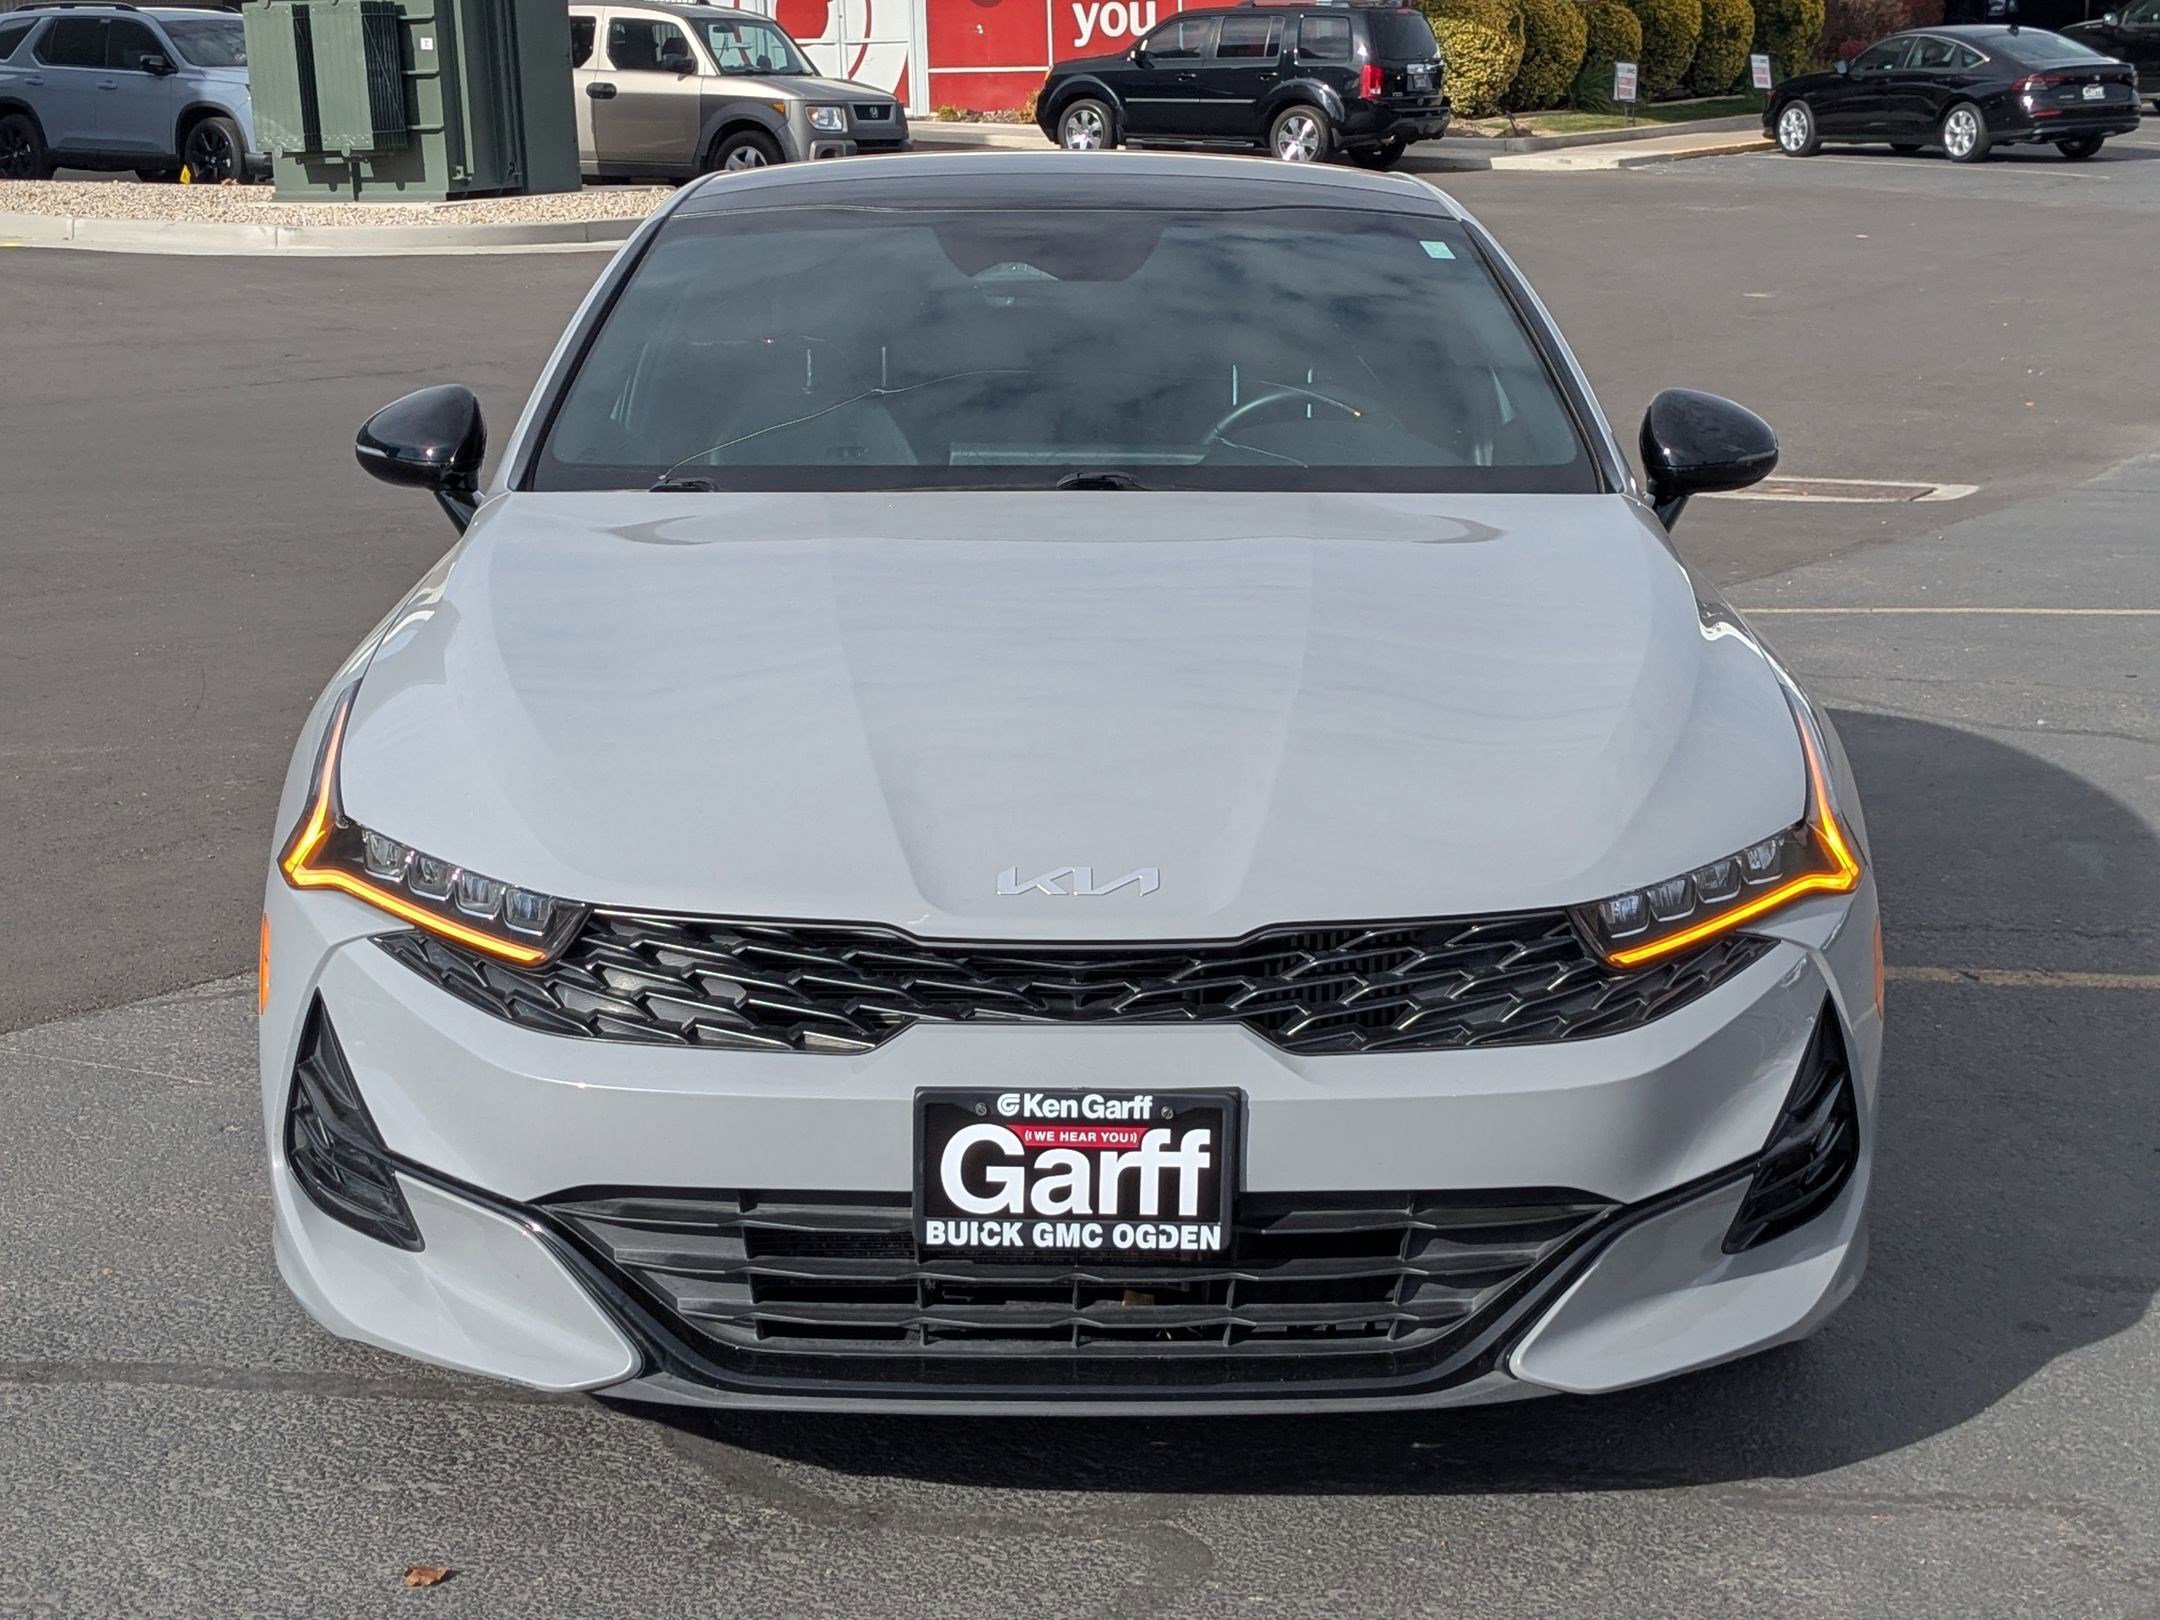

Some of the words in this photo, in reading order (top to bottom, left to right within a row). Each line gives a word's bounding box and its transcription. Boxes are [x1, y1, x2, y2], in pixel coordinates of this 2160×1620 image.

[1072, 0, 1156, 47] you
[1023, 1093, 1078, 1118] Ken
[1081, 1094, 1153, 1119] Garff
[1059, 1131, 1097, 1142] HEAR
[940, 1123, 1211, 1216] Garff
[926, 1220, 1024, 1246] BUICK
[1032, 1222, 1103, 1248] GMC
[1112, 1223, 1221, 1250] OGDEN
